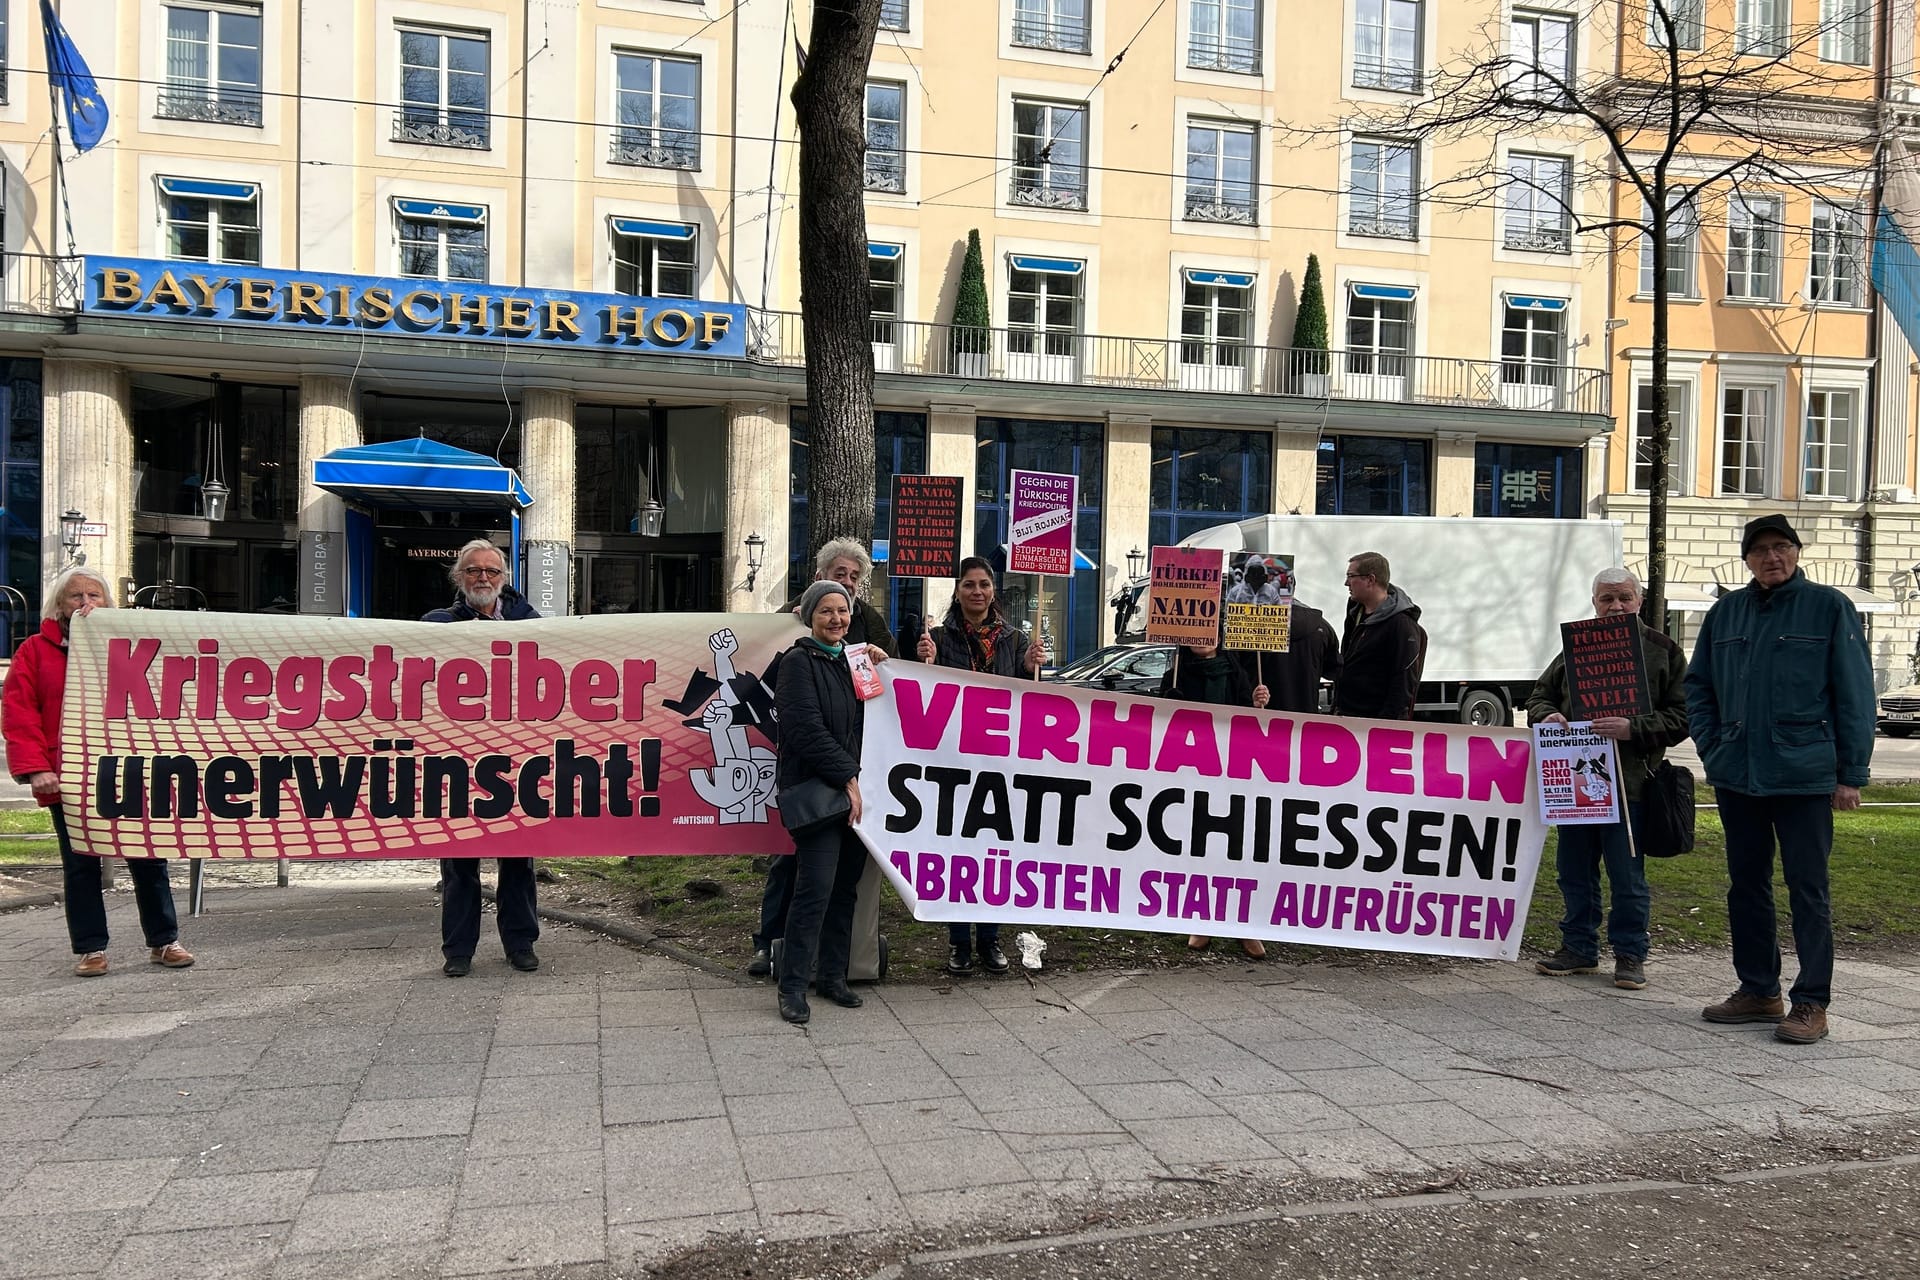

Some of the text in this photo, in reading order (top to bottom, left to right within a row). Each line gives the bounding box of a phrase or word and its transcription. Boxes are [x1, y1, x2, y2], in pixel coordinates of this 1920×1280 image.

[98, 267, 734, 345] BAYERISCHER HOF
[899, 476, 956, 485] WIR KLAGEN
[1020, 477, 1068, 489] GEGEN DIE
[900, 487, 956, 498] AN: NATO,
[1019, 488, 1068, 502] TÜRKISCHE
[898, 499, 956, 507] DEUTSCHLAND
[898, 516, 954, 527] DER TÜRKEI
[898, 528, 954, 537] BEI IHREM
[1016, 526, 1032, 538] BIJI
[897, 538, 954, 547] VÖLKERMORD
[896, 549, 952, 562] AN DEN
[1016, 546, 1067, 557] STOPPT DEN
[1015, 554, 1057, 563] EINMARSCH
[896, 564, 952, 576] KURDEN!
[1015, 561, 1067, 572] NORD-SYRIEN!
[1154, 564, 1219, 582] TÜRKEI
[314, 562, 327, 602] POLAR
[542, 569, 554, 608] POLAR
[1152, 597, 1216, 618] NATO
[1228, 604, 1288, 616] DIE TÜRKEI
[1151, 616, 1215, 627] FINANZIERT!
[1227, 627, 1287, 635] KRIEGSRECHT!
[1572, 627, 1631, 645] TÜRKEI
[1149, 634, 1215, 646] #DEFENDKURDISTAN
[1225, 641, 1287, 650] CHEMIEWAFFEN!
[1573, 640, 1632, 654] BOMBARDIERT
[1574, 650, 1633, 665] KURDISTAN
[1576, 661, 1635, 678] UND DER
[103, 638, 658, 730] Kriegstreiber
[1577, 675, 1637, 690] REST DER
[1580, 688, 1638, 708] WELT
[892, 678, 1530, 804] VERHANDELN
[1540, 736, 1607, 748] unerwünscht!
[1542, 759, 1569, 768] ANTI
[96, 737, 662, 819] unerwünscht!
[1543, 769, 1570, 778] SIKO
[1543, 778, 1571, 786] DEMO
[672, 815, 715, 825] #ANTISIKO
[885, 763, 1521, 882] STATT SCHIESSEN!
[889, 848, 1516, 942] ABRÜSTEN STATT AUFRÜSTEN
